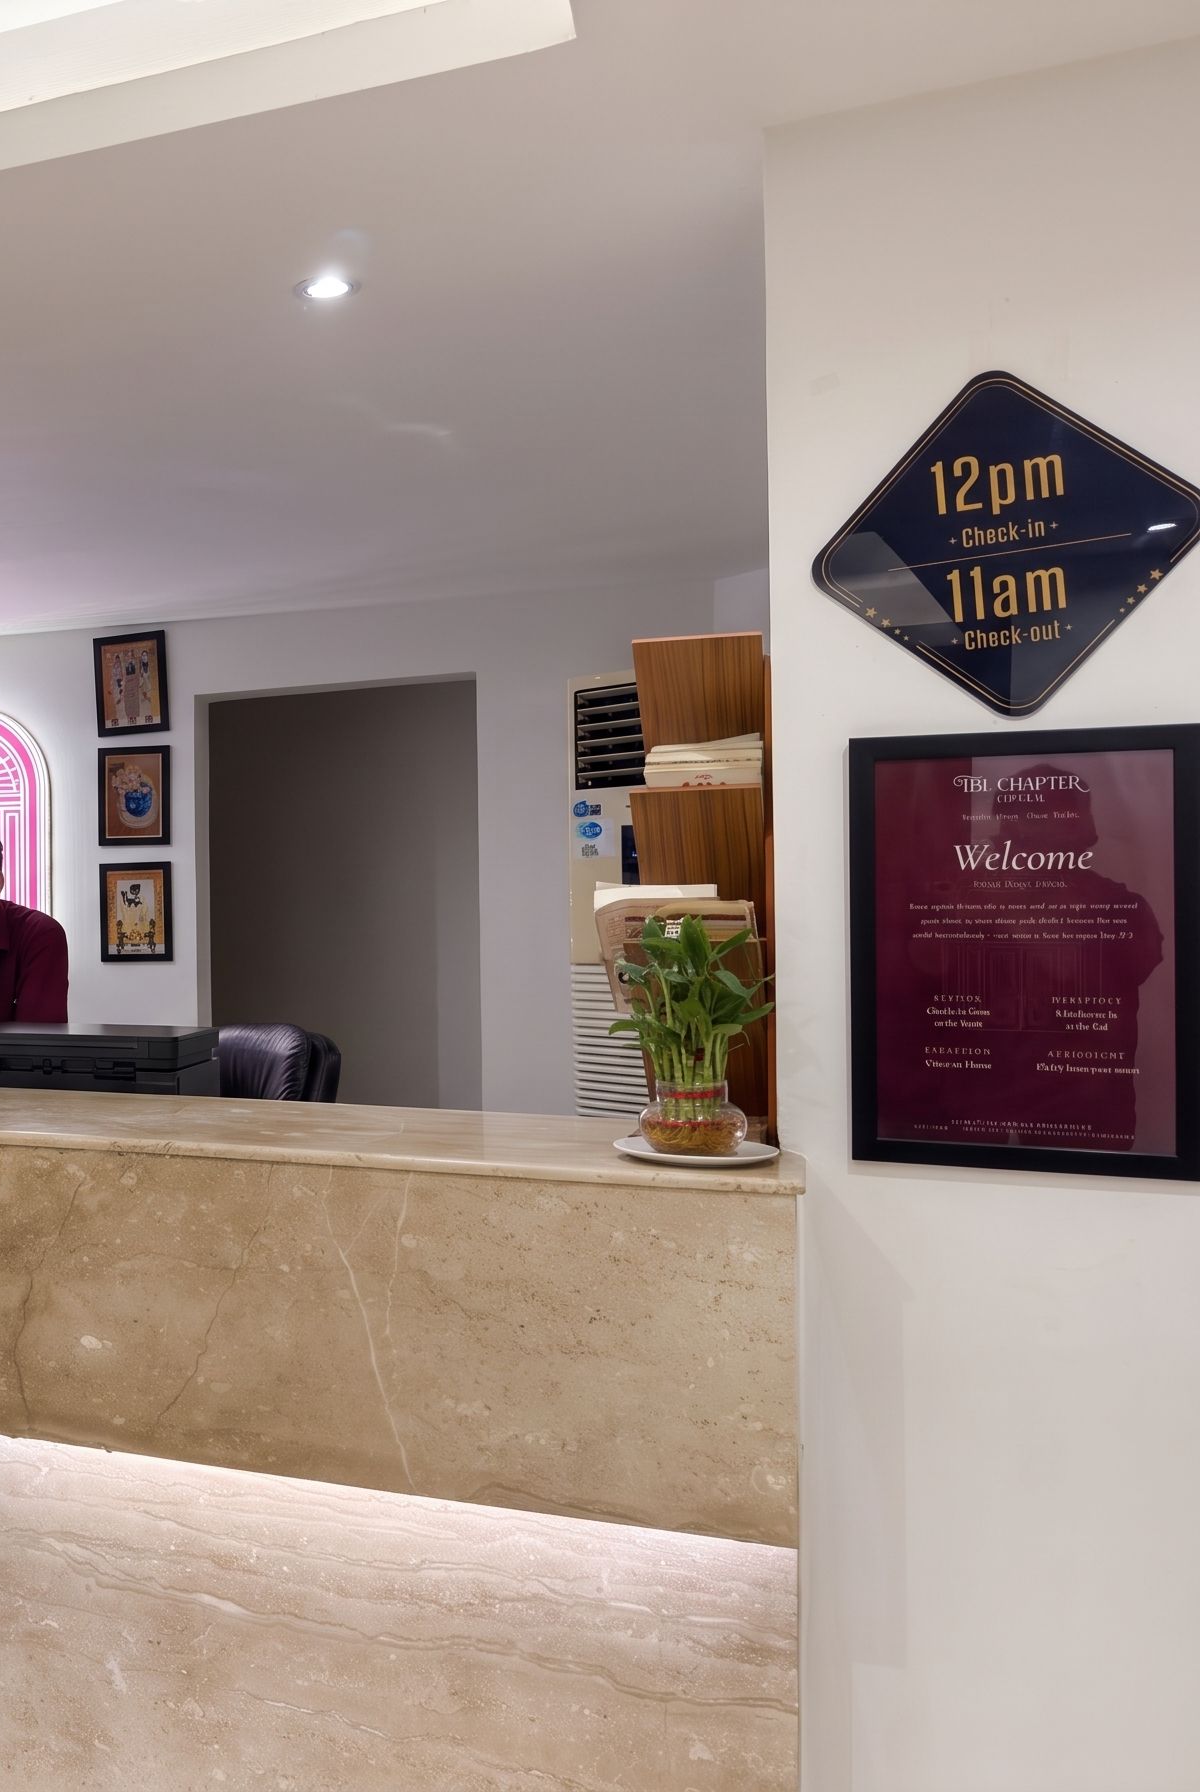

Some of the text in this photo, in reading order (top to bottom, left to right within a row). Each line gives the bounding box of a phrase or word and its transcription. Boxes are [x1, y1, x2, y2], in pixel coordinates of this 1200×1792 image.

[930, 453, 1065, 515] 12pm
[961, 519, 1046, 548] Check-in
[946, 565, 1067, 622] 11am
[964, 622, 1061, 650] Check-out
[997, 775, 1090, 793] CHAPTER
[953, 839, 1094, 871] Welcome
